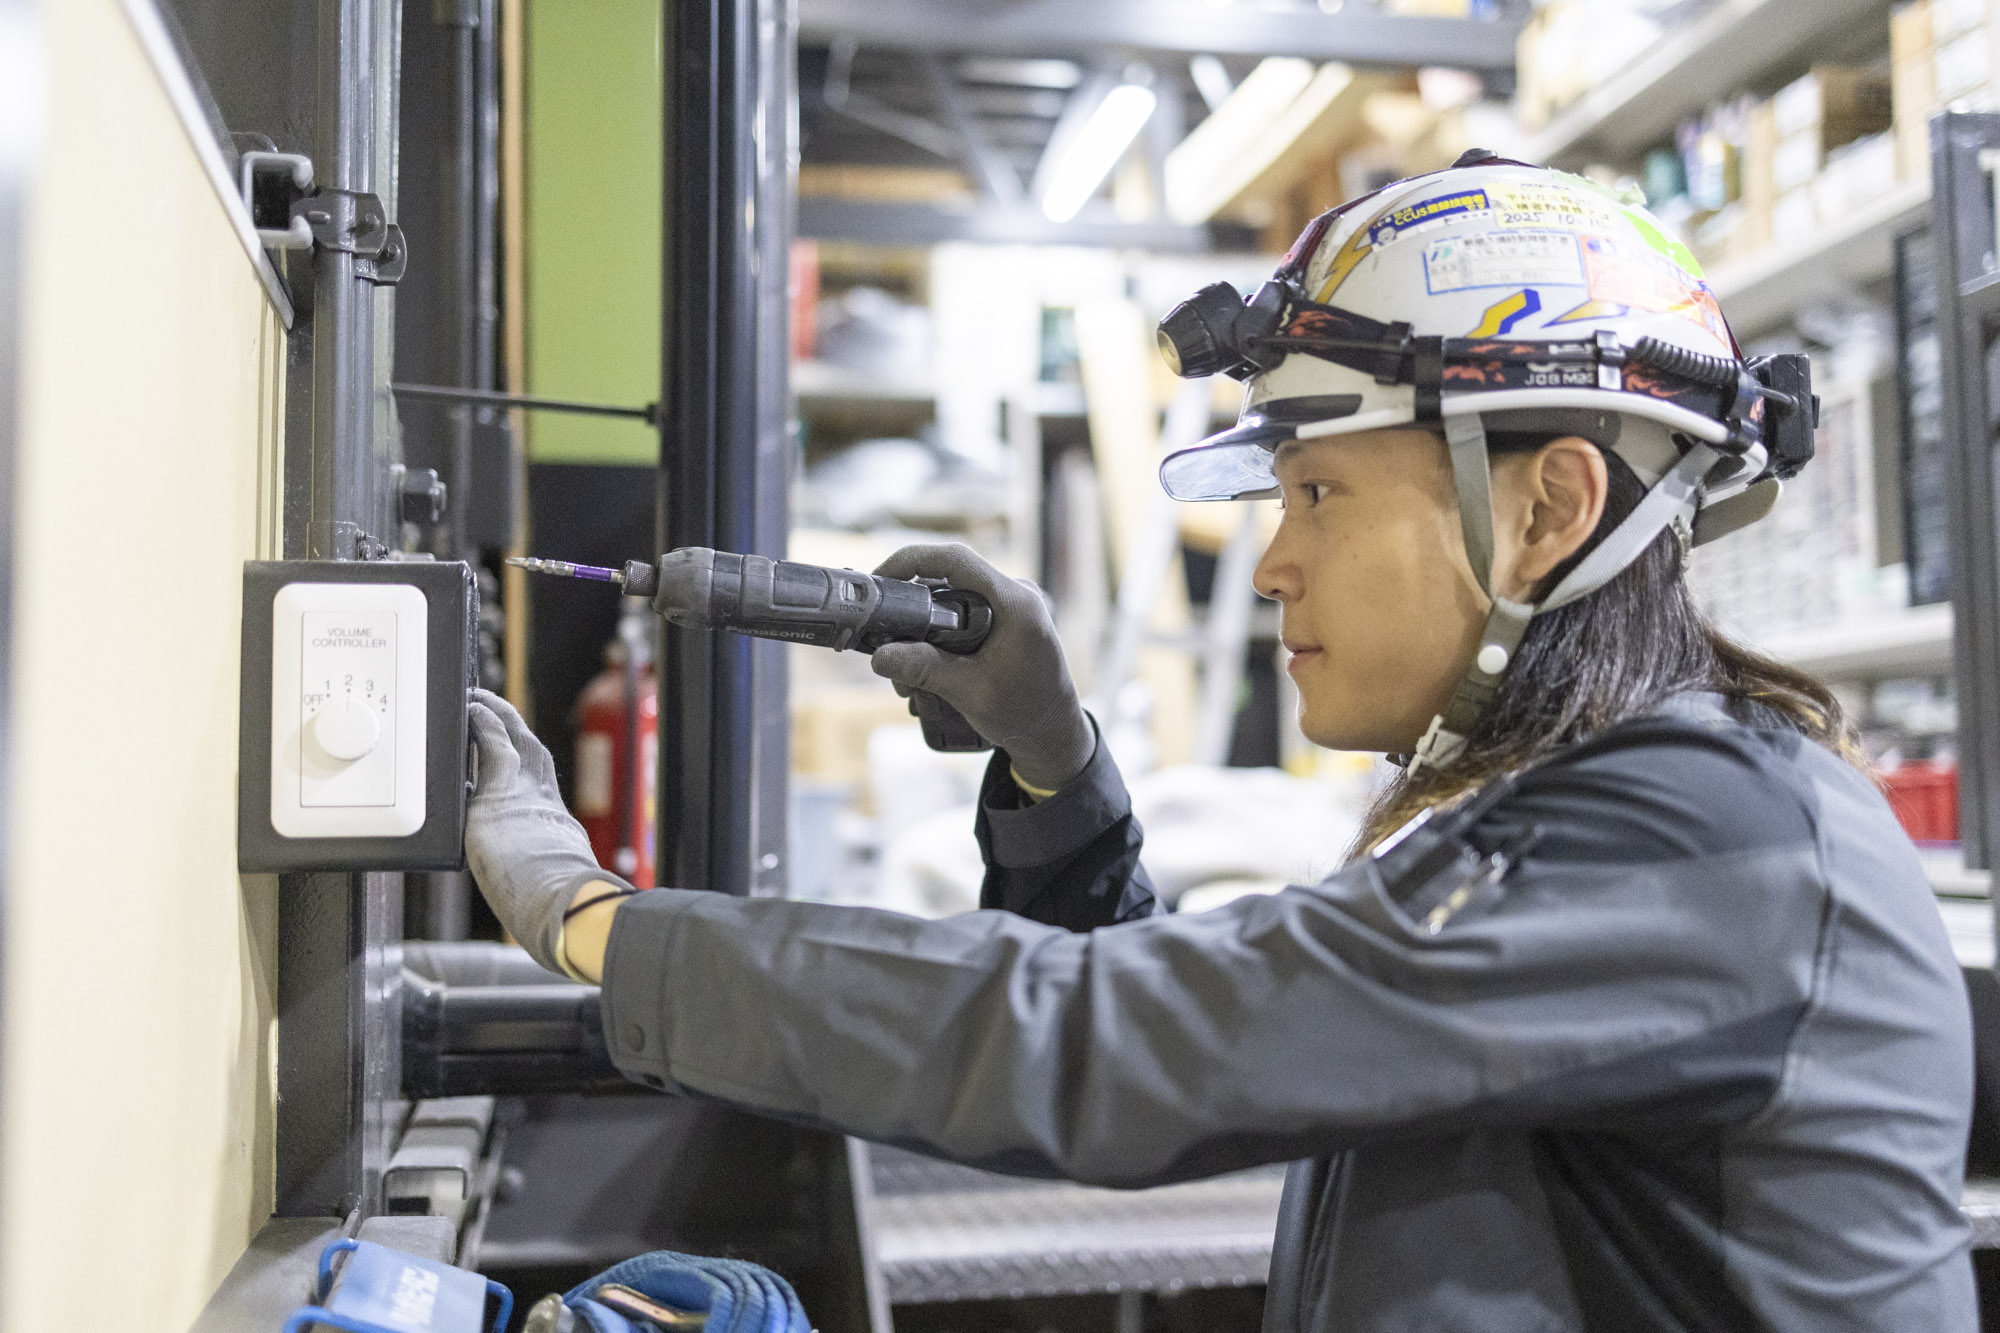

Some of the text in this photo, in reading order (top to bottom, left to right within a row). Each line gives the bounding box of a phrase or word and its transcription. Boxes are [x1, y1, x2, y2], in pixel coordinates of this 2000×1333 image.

[1503, 212, 1544, 224] 2025
[1558, 214, 1575, 225] 10
[1524, 372, 1561, 386] JOB
[839, 603, 857, 614] LOCK
[327, 628, 372, 637] VOLUME
[312, 638, 387, 648] CONTROLLER
[325, 680, 331, 690] 1
[344, 674, 353, 686] 2
[366, 680, 374, 691] 3
[303, 694, 324, 705] OFF
[379, 695, 388, 705] 4
